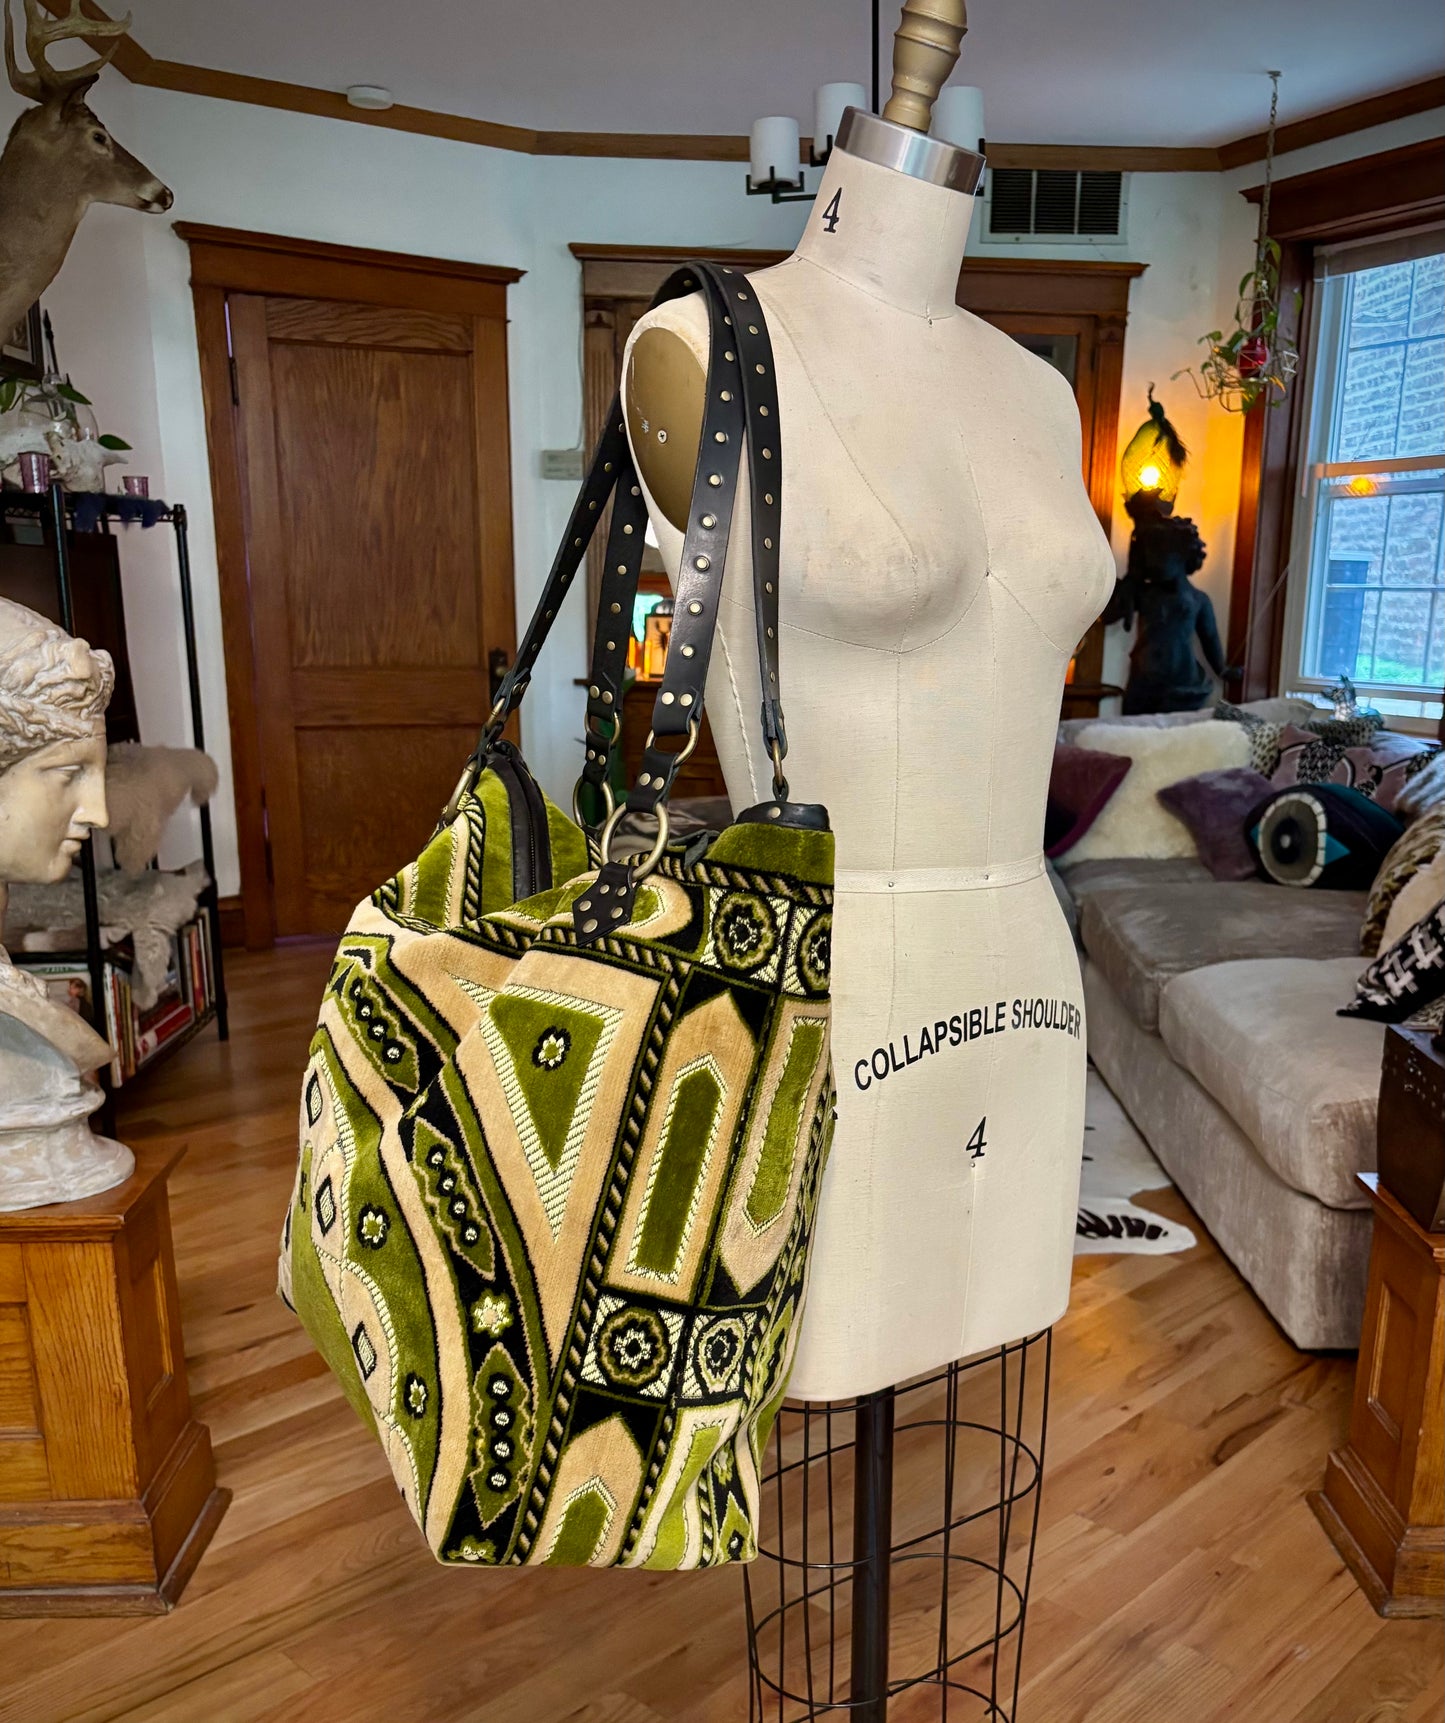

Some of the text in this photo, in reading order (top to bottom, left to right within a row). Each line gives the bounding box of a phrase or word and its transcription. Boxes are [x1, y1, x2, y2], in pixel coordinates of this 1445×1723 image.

[822, 187, 842, 233] 4
[854, 998, 1081, 1090] COLLAPSIBLE SHOULDER
[965, 1116, 988, 1158] 4
